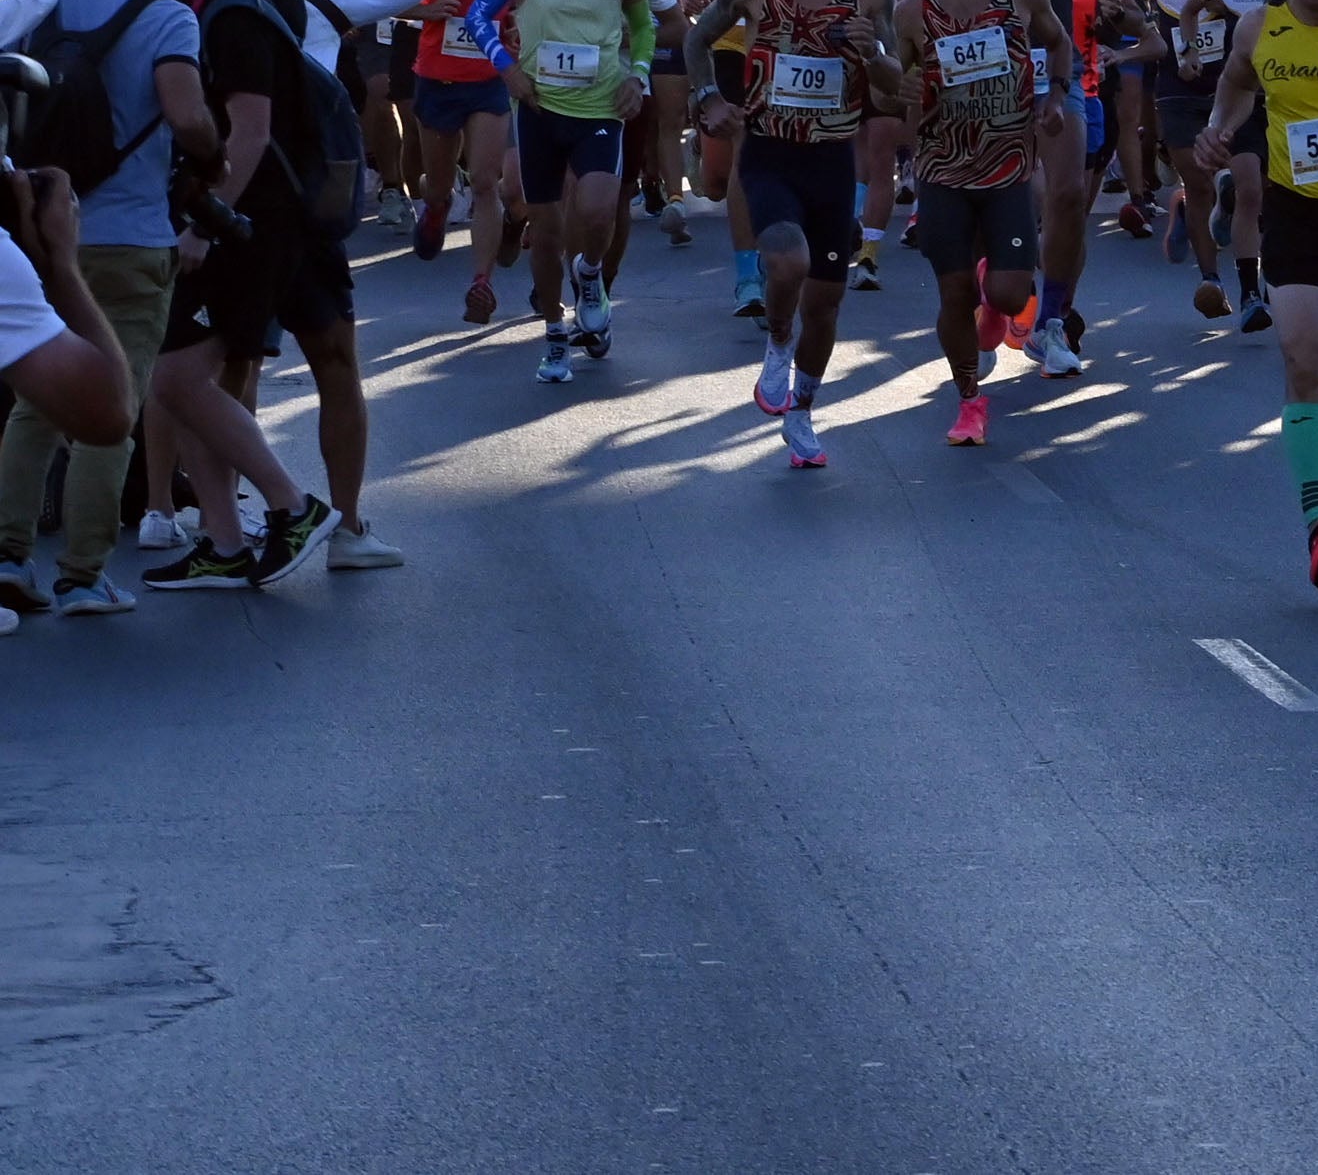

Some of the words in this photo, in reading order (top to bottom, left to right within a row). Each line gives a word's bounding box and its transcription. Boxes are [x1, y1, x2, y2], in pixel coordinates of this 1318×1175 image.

[556, 52, 575, 71] 11
[954, 40, 986, 65] 647
[791, 67, 825, 89] 709
[941, 92, 1020, 122] DUMBBELLS
